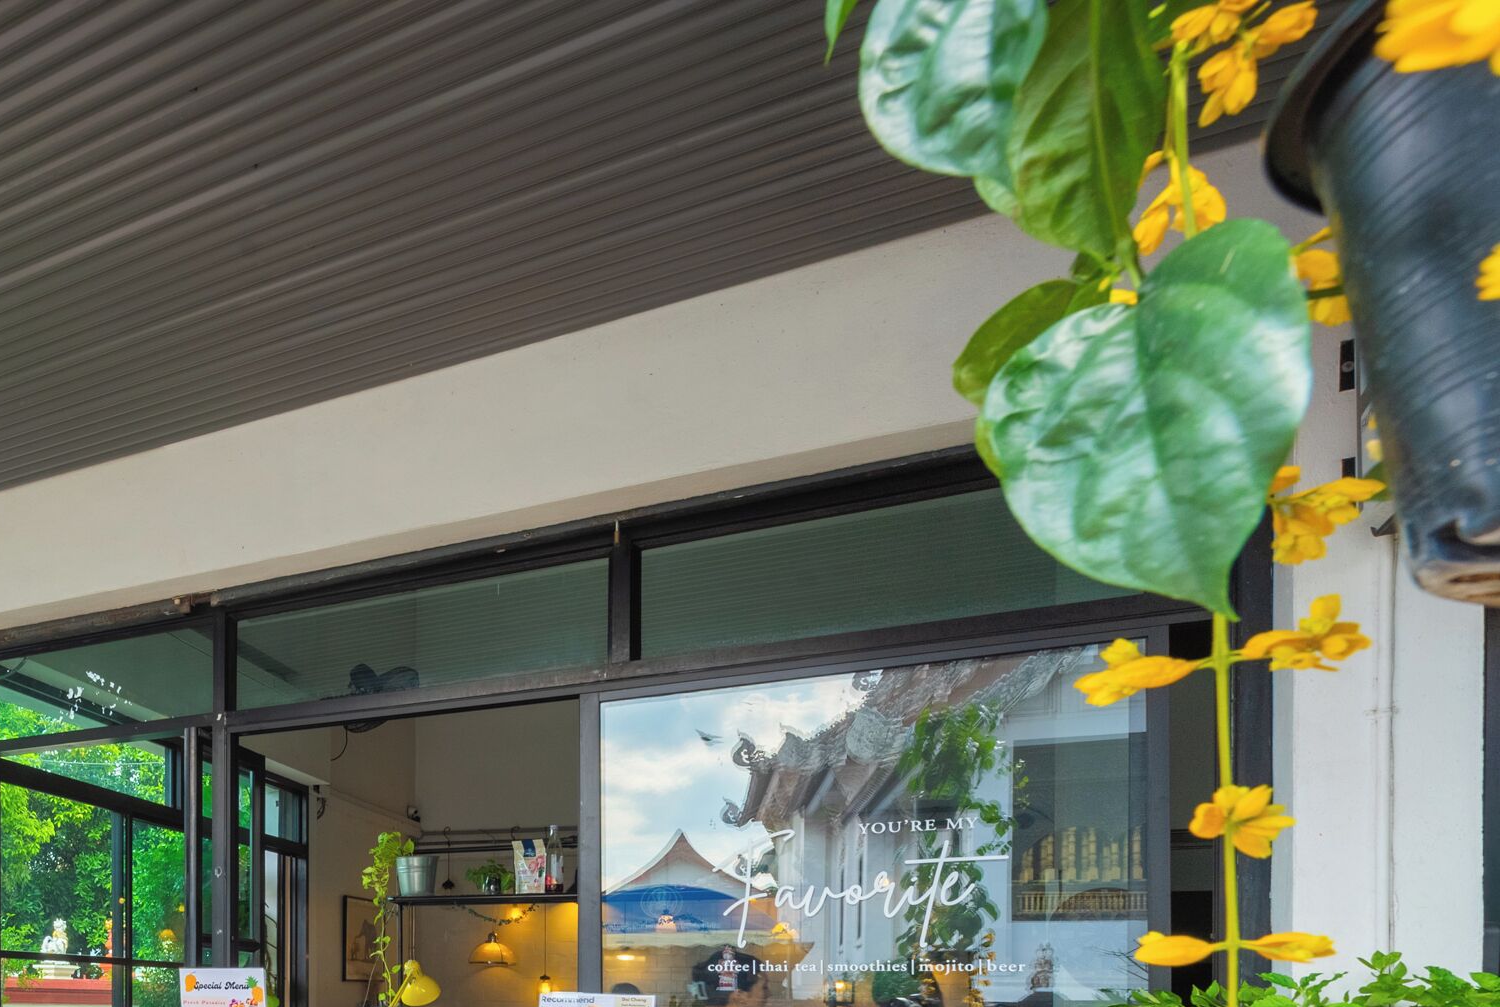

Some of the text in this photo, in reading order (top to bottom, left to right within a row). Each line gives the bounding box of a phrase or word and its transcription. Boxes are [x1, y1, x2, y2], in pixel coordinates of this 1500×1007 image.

[859, 817, 980, 834] YOU'RE MY
[712, 829, 1009, 948] Favorite
[707, 959, 1026, 975] coffee thai tea smoothies mojito beer
[194, 981, 250, 991] Special Menu
